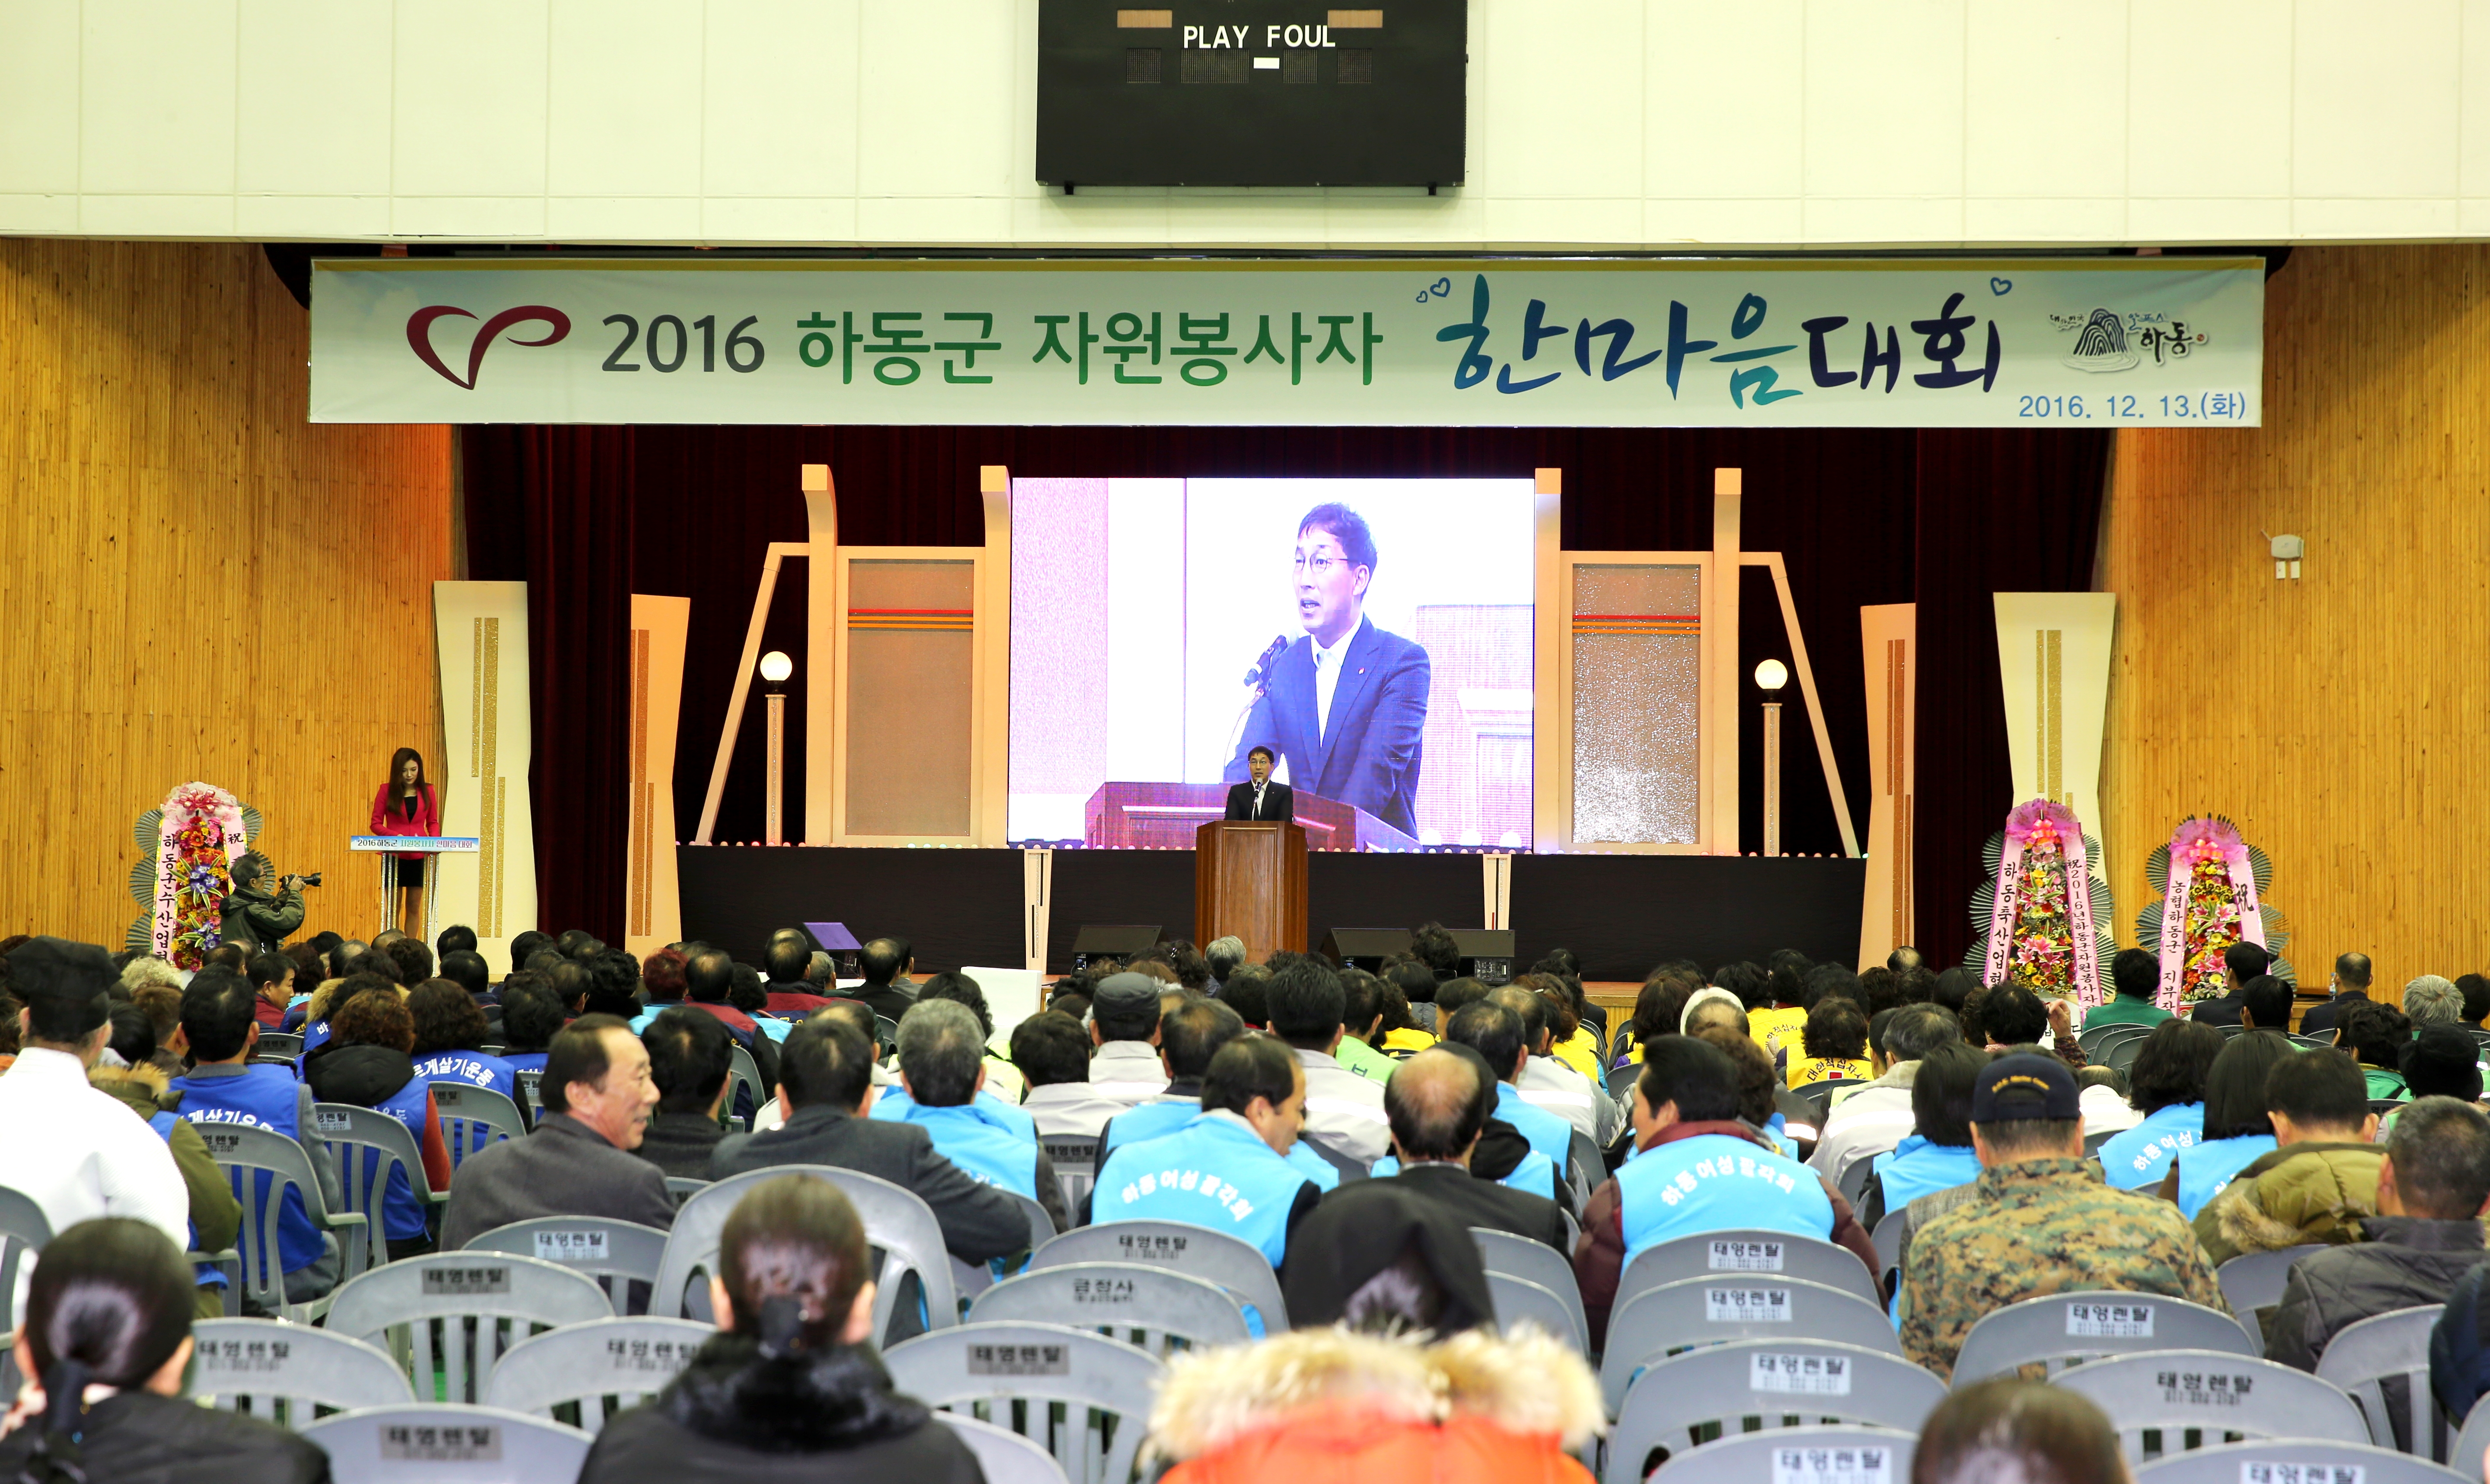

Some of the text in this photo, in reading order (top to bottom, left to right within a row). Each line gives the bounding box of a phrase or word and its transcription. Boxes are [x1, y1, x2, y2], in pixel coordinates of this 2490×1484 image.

[1184, 24, 1336, 48] PLAY FOUL
[602, 313, 765, 373] 2016
[797, 311, 1002, 386] 하동군
[1032, 312, 1384, 386] 자원봉사자
[2140, 322, 2193, 363] 하동
[2019, 395, 2091, 419] 2016.
[2107, 395, 2144, 419] 12.
[539, 1232, 602, 1246] 태영렌탈
[1119, 1234, 1187, 1250] 태영렌탈
[1714, 1242, 1779, 1257] 태영렌탈
[1712, 1290, 1785, 1305] 태영렌탈
[2074, 1304, 2148, 1322] 태영렌탈
[1759, 1354, 1844, 1375] 태영렌탈
